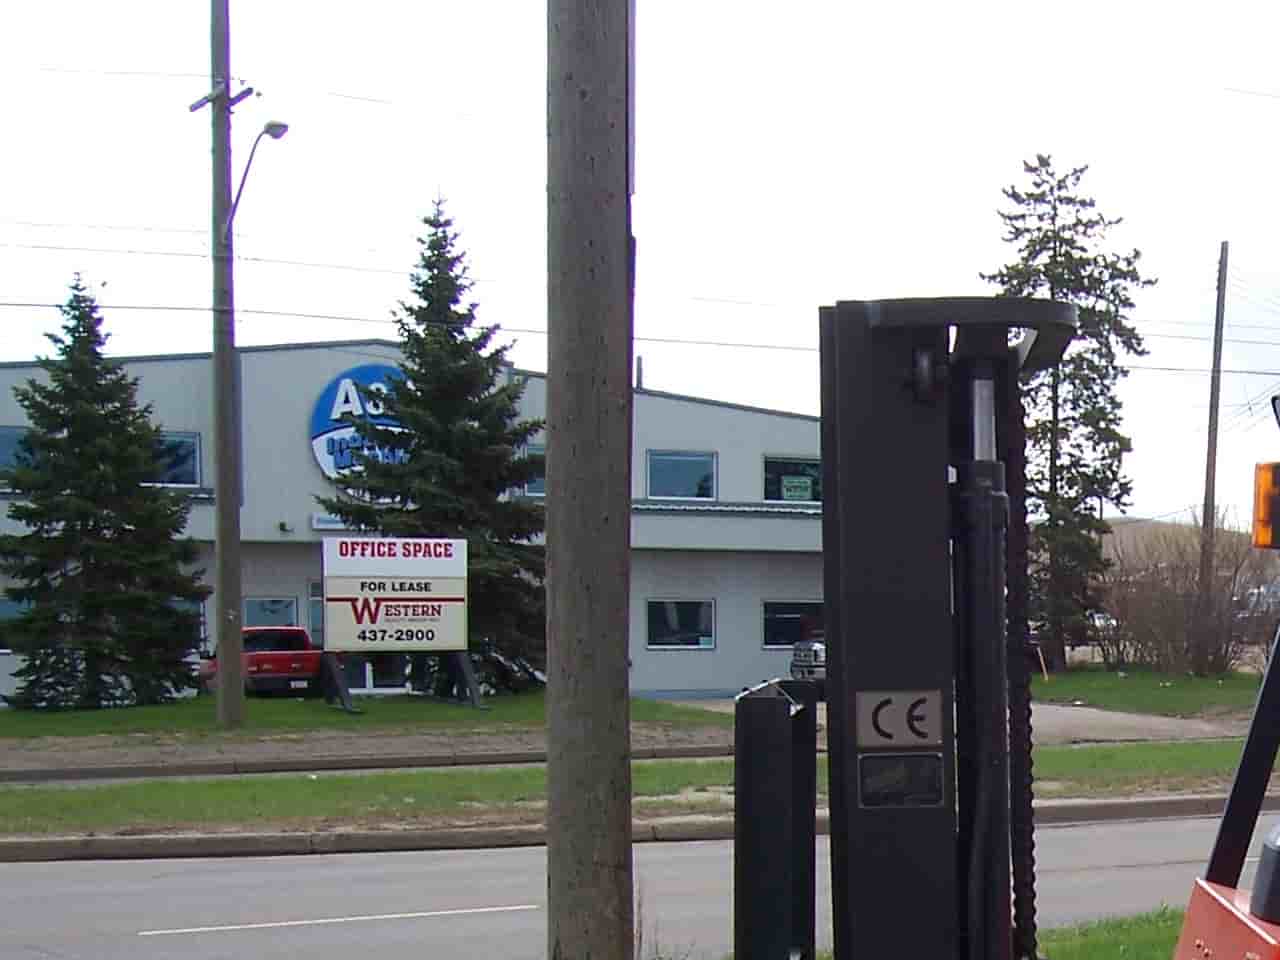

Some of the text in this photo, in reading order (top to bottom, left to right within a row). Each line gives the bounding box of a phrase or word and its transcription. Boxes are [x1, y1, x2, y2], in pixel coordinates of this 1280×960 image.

[339, 541, 453, 558] OFFICE SPACE
[360, 581, 432, 592] FOR LEASE
[351, 598, 442, 625] WESTERN
[357, 629, 435, 641] 437-2900
[872, 696, 928, 739] CE
